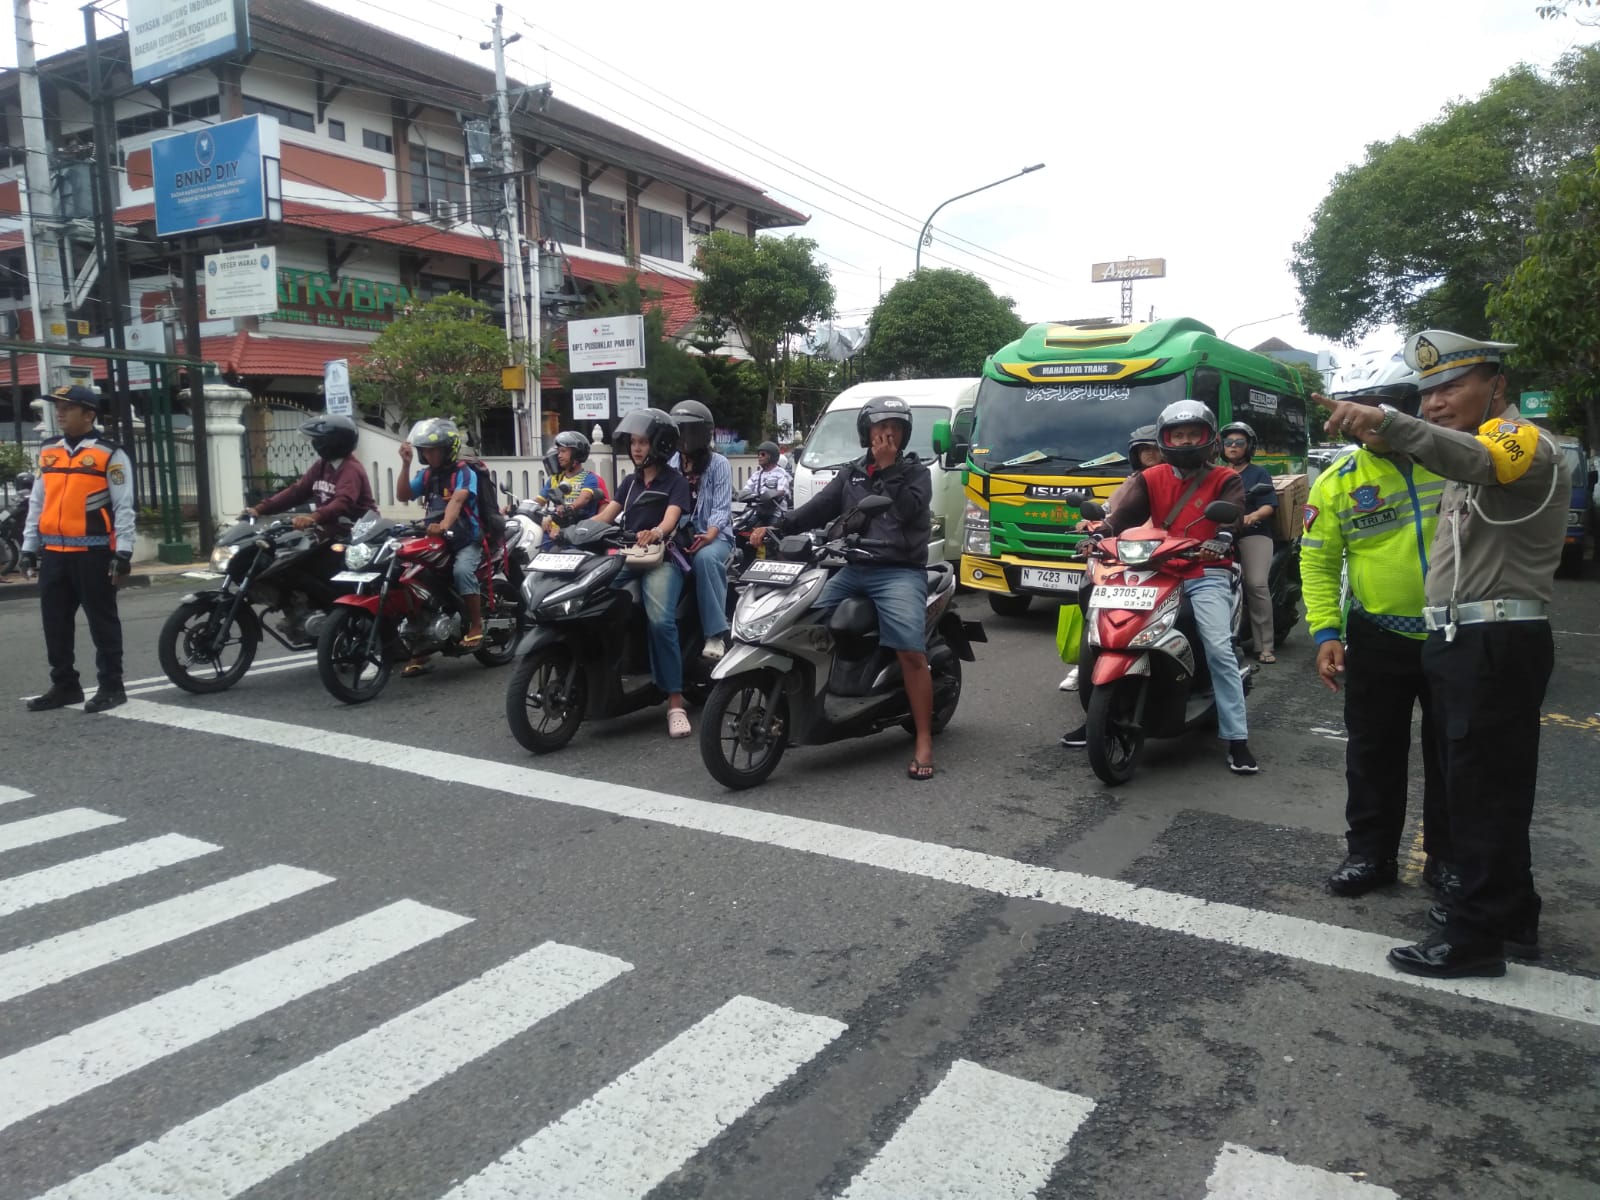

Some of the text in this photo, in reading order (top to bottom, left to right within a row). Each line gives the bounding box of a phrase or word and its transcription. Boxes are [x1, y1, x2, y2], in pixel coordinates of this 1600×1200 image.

[175, 160, 240, 189] BNNP DIY
[1042, 364, 1109, 375] MAHA DAYA TRANS
[1502, 439, 1525, 462] OPS
[1032, 486, 1086, 497] ISUZU
[1023, 569, 1030, 580] N
[1093, 588, 1157, 599] AB 3705 WJ
